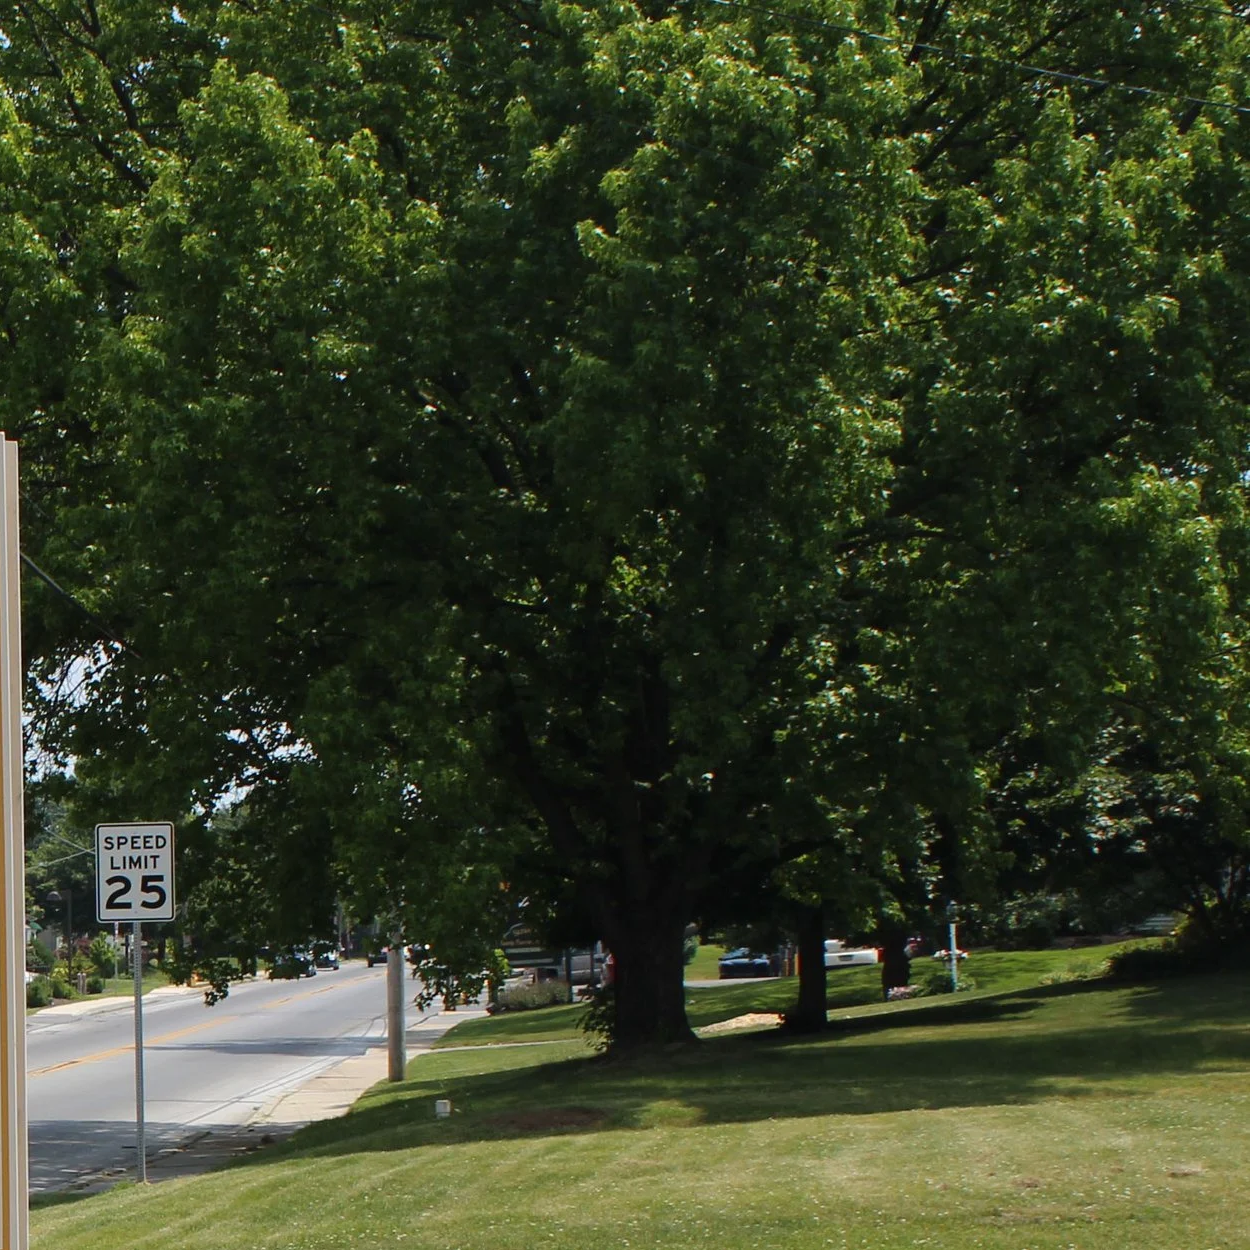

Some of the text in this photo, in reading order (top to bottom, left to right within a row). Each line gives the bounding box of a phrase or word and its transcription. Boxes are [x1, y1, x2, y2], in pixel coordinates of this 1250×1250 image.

[104, 835, 167, 850] SPEED
[110, 855, 160, 870] LIMIT
[105, 875, 167, 910] 25
